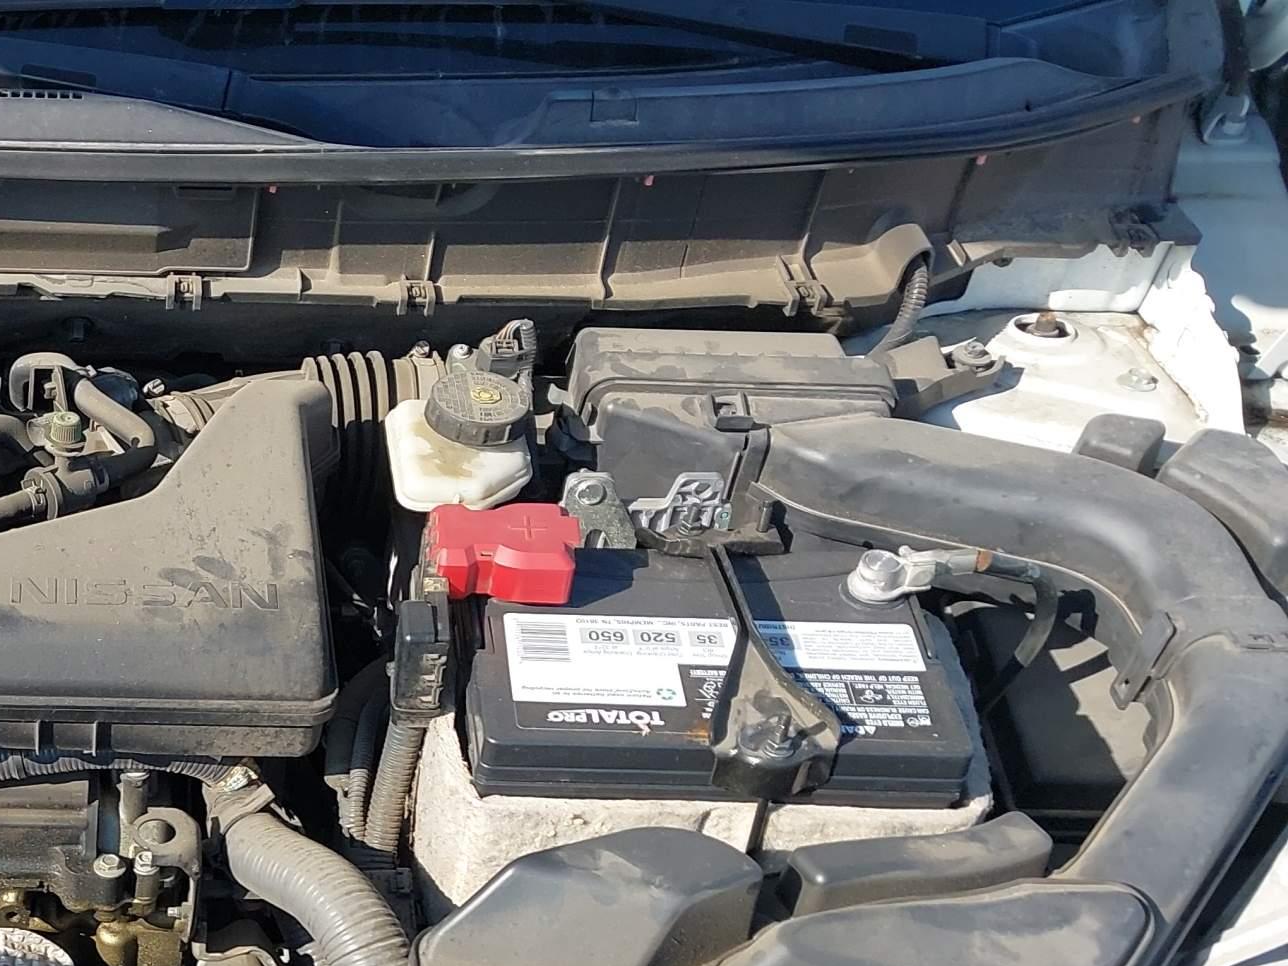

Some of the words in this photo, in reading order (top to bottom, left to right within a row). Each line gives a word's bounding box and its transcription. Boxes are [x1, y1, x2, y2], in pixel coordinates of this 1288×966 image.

[9, 576, 280, 611] NISSAN
[588, 631, 624, 642] 650
[640, 632, 676, 643] 520
[697, 634, 718, 645] 35
